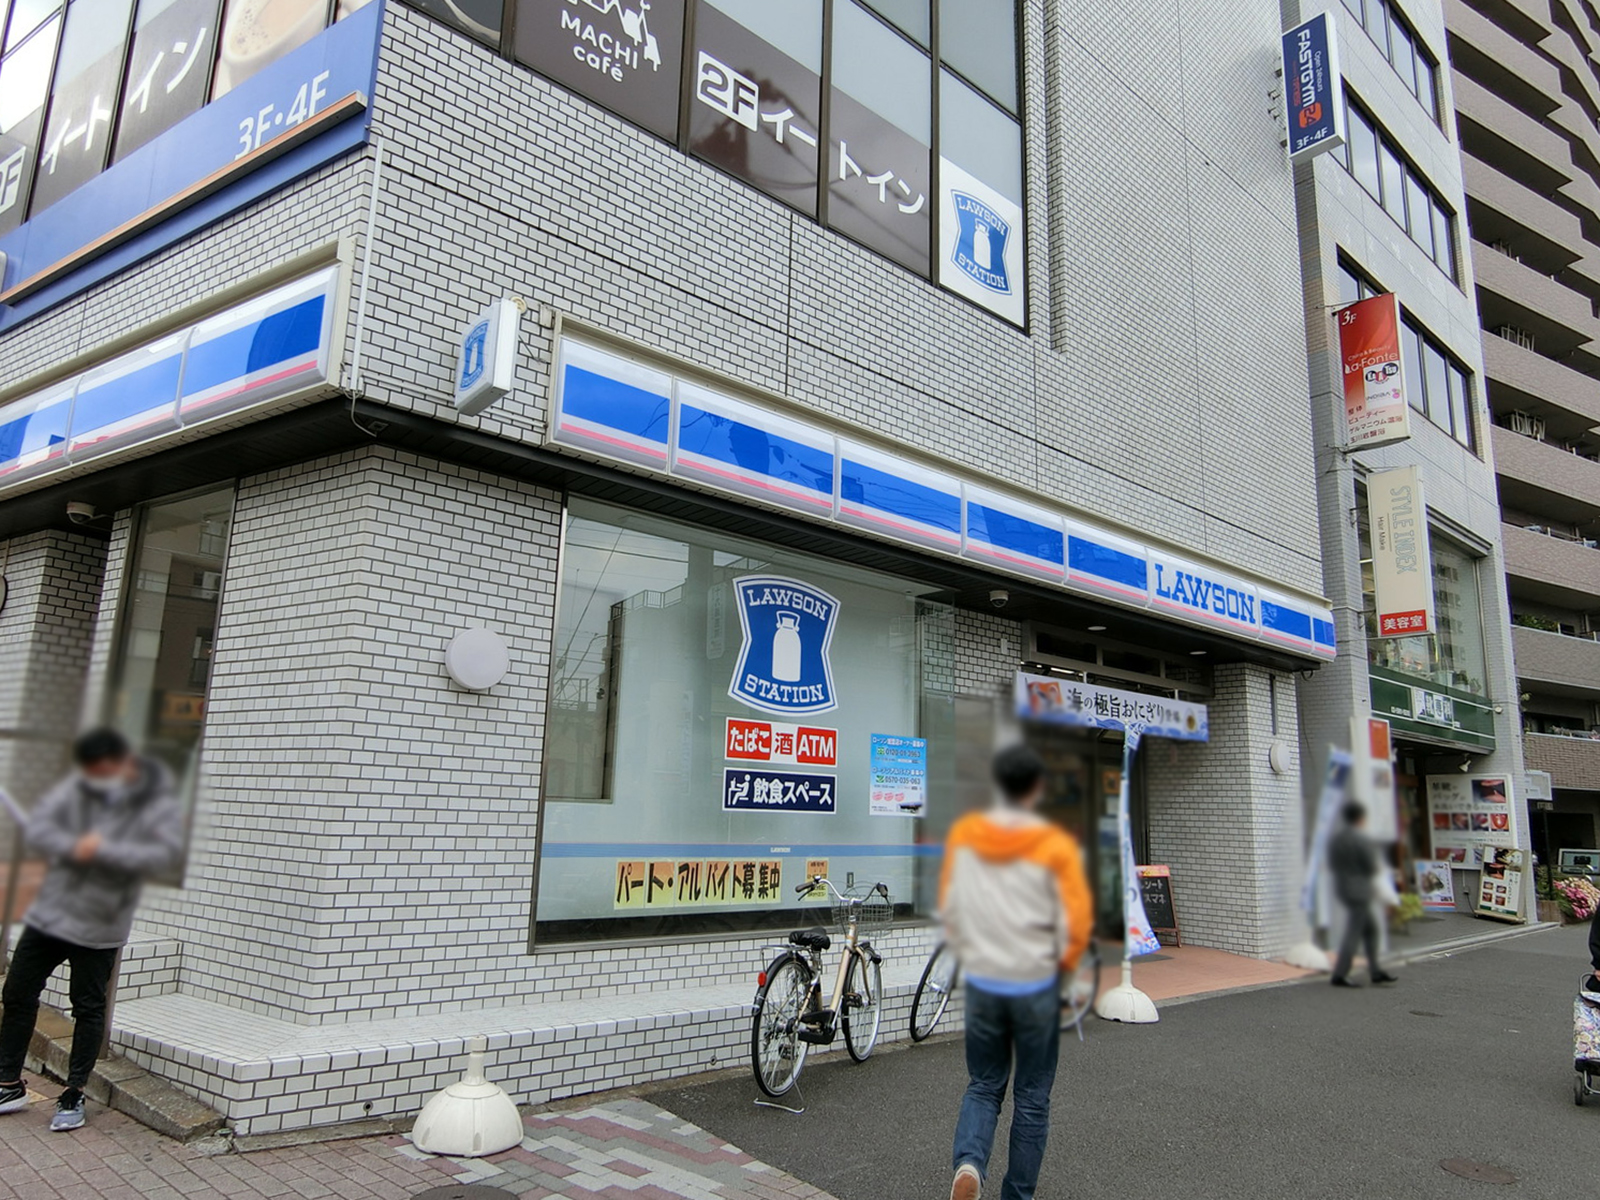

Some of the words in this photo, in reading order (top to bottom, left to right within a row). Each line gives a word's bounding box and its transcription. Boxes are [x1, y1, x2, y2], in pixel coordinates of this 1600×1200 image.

[559, 9, 638, 70] MACHI
[573, 45, 624, 83] café
[40, 27, 207, 176] イートイン
[760, 108, 925, 215] イートイン
[957, 197, 1006, 236] LAWSON
[958, 252, 1006, 289] STATION
[1341, 310, 1357, 326] 3F
[746, 588, 828, 621] LAWSON
[1154, 563, 1257, 625] LAWSON
[1383, 615, 1424, 631] 美容室
[744, 674, 825, 703] STATION
[729, 726, 771, 754] たばこ
[774, 732, 794, 756] 酒
[797, 734, 834, 759] ATM
[753, 777, 832, 805] 飲食スペース
[616, 862, 780, 904] パート・アルバイト募集中
